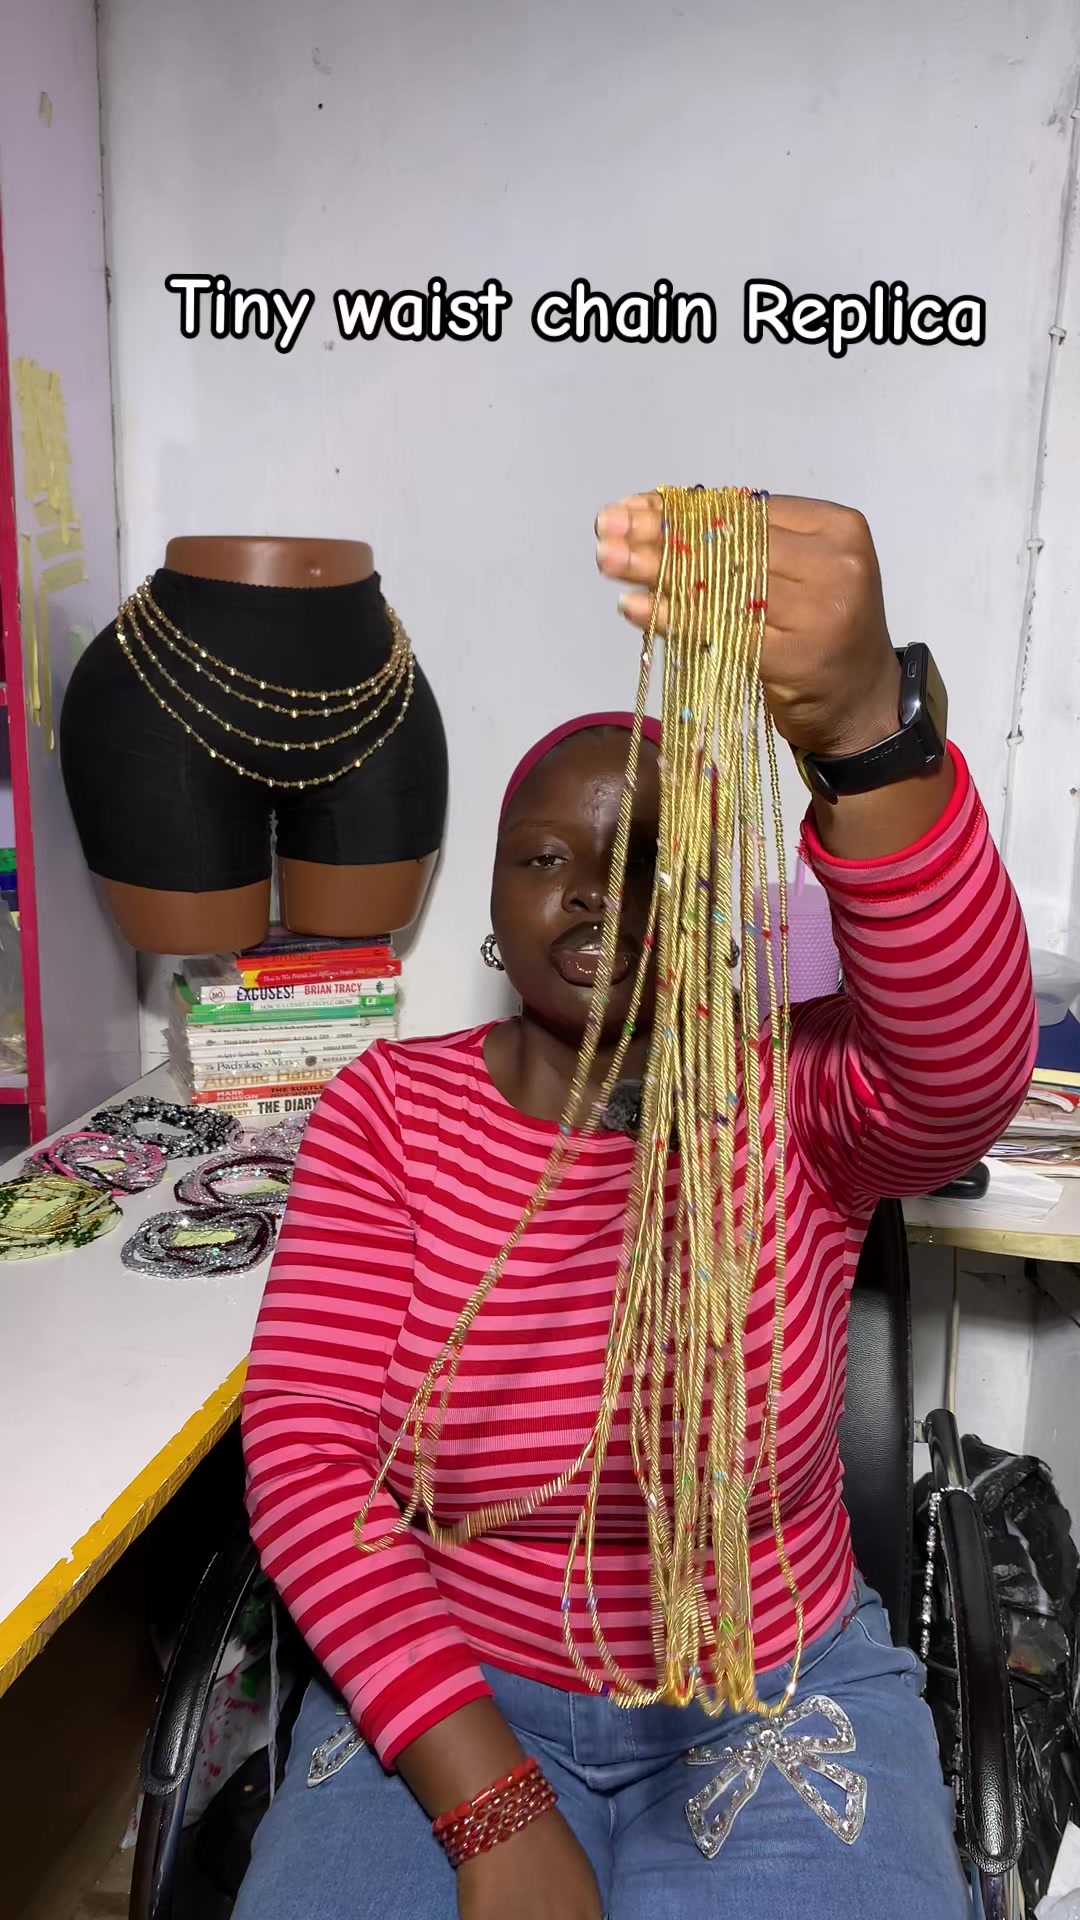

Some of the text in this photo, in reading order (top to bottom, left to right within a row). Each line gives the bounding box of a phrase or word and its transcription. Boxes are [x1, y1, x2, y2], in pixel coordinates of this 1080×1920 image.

[212, 984, 295, 1002] NO EXCUSES!
[304, 982, 362, 995] BRIAN TRACY
[217, 1060, 263, 1072] Psychology
[271, 1058, 300, 1068] Money
[203, 1068, 333, 1089] Atomic Habits
[217, 1102, 249, 1110] STEVEN
[257, 1096, 319, 1114] THE DIARY
